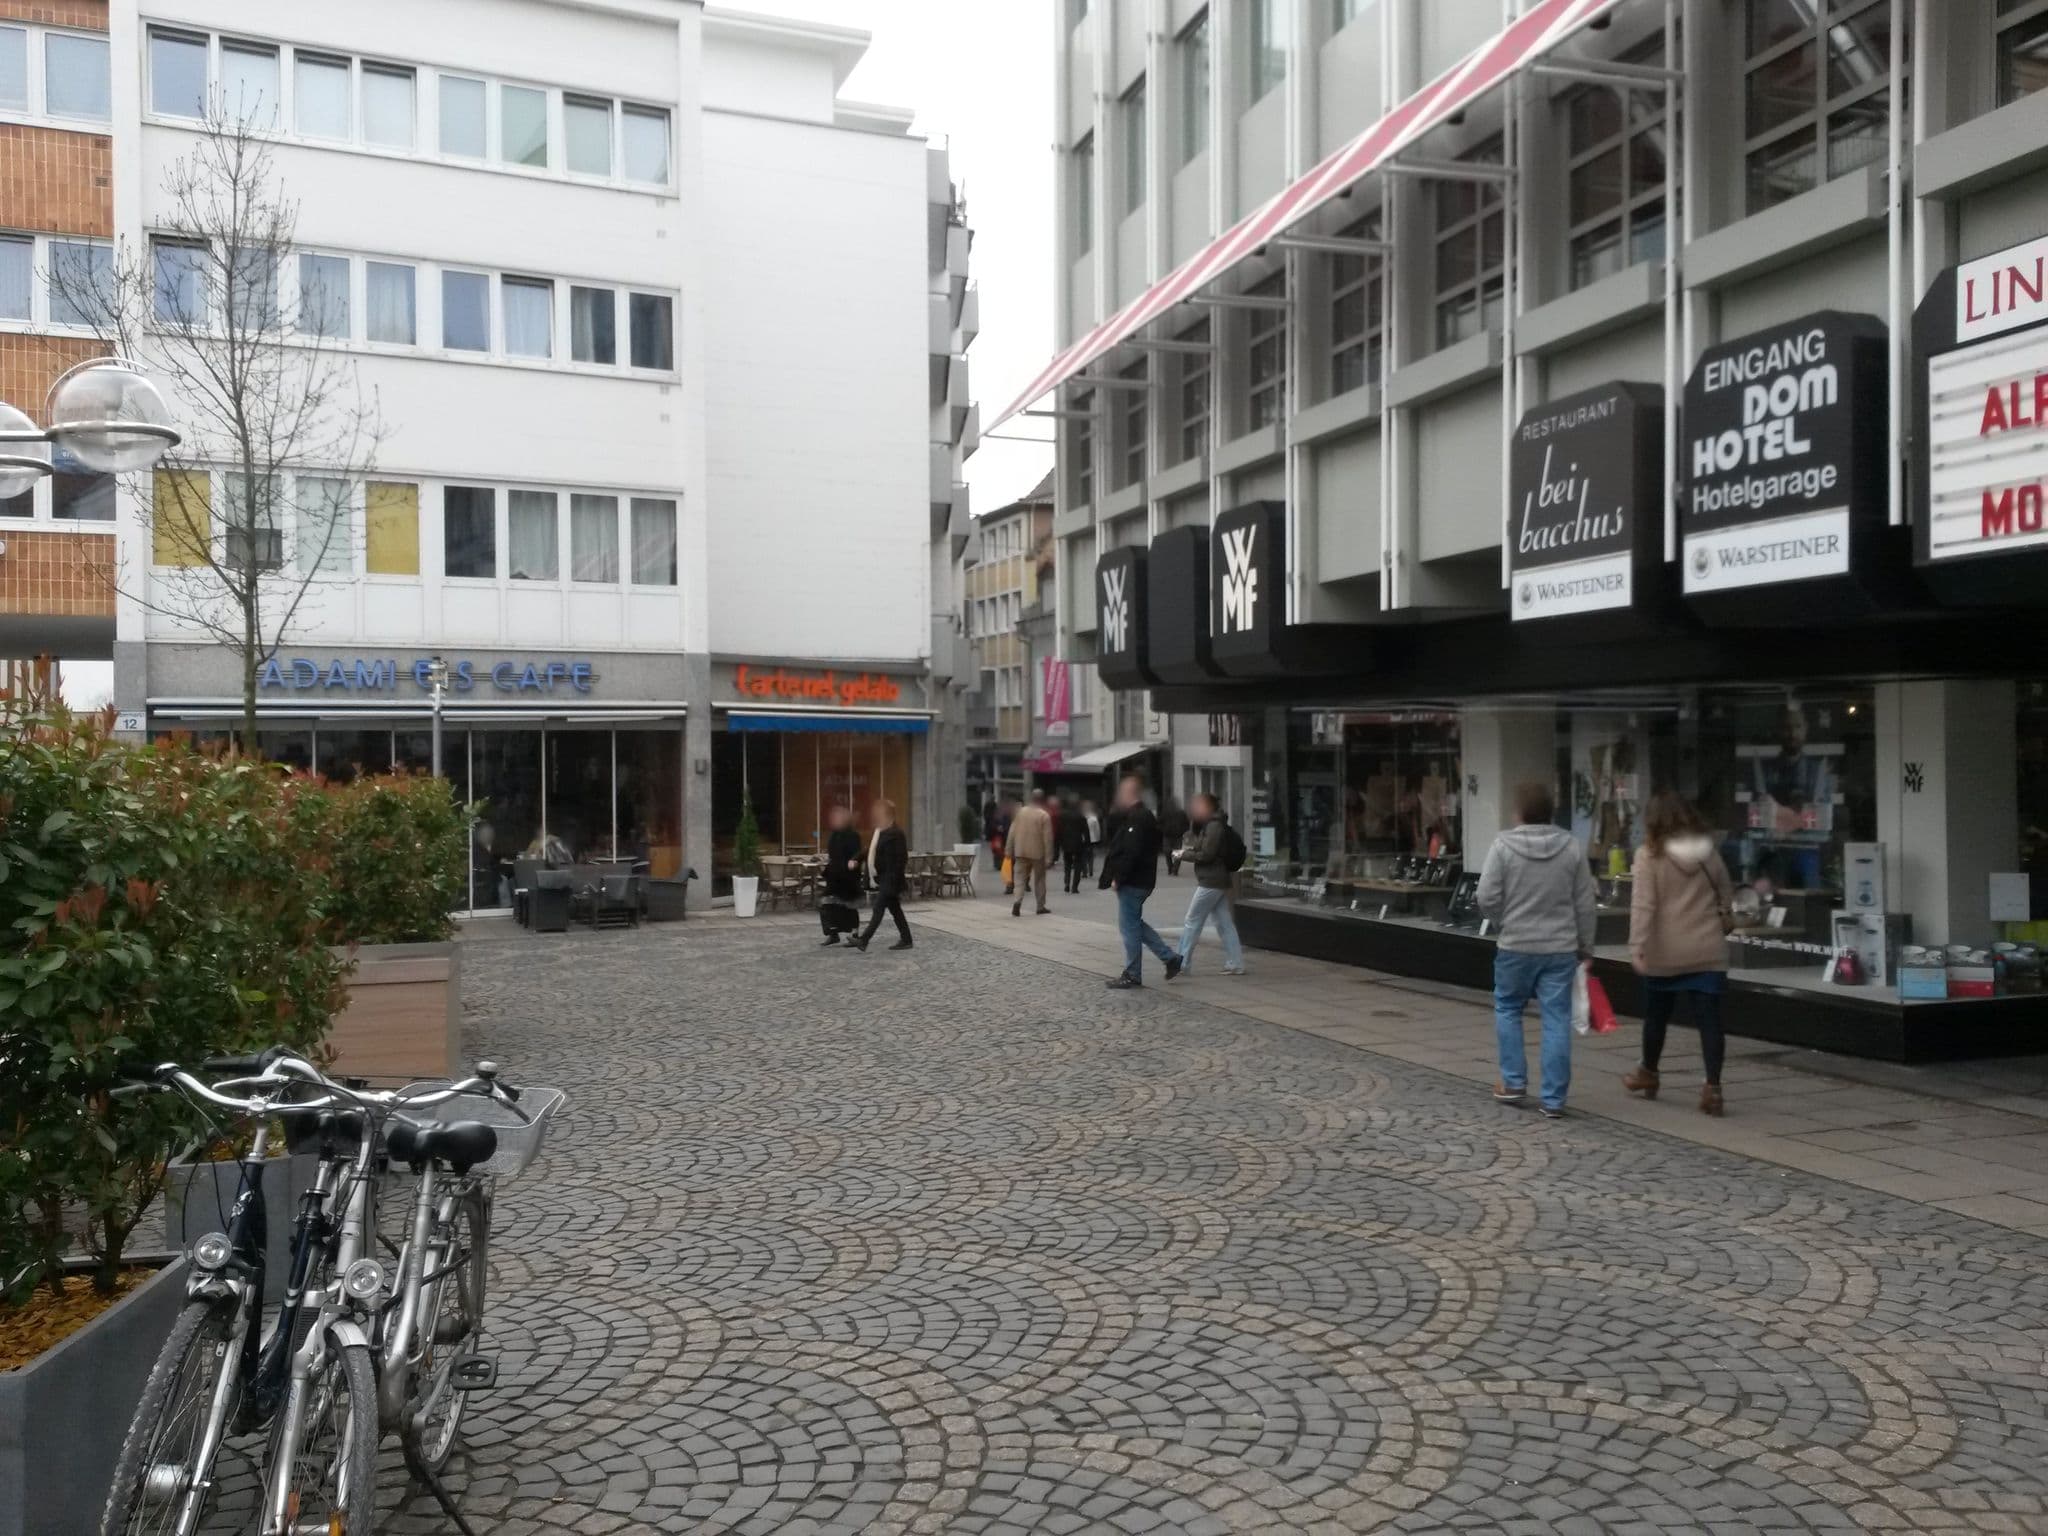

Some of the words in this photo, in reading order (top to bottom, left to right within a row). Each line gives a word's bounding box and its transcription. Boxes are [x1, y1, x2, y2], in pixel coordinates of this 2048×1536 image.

[1704, 329, 1826, 393] EINGANG
[1743, 363, 1838, 427] DOM
[1522, 397, 1618, 441] RESTAURANT
[1693, 416, 1811, 479] HOTEL
[1539, 444, 1578, 508] bei
[1692, 464, 1838, 515] Hotelgarage
[1519, 478, 1624, 554] bacchus
[1717, 534, 1840, 569] WARSTEINER
[1535, 572, 1625, 602] WARSTEINER
[261, 659, 396, 690] ADAMI
[414, 660, 474, 690] ES
[490, 662, 593, 694] CAFE
[840, 671, 901, 707] gelato
[122, 719, 137, 729] 12
